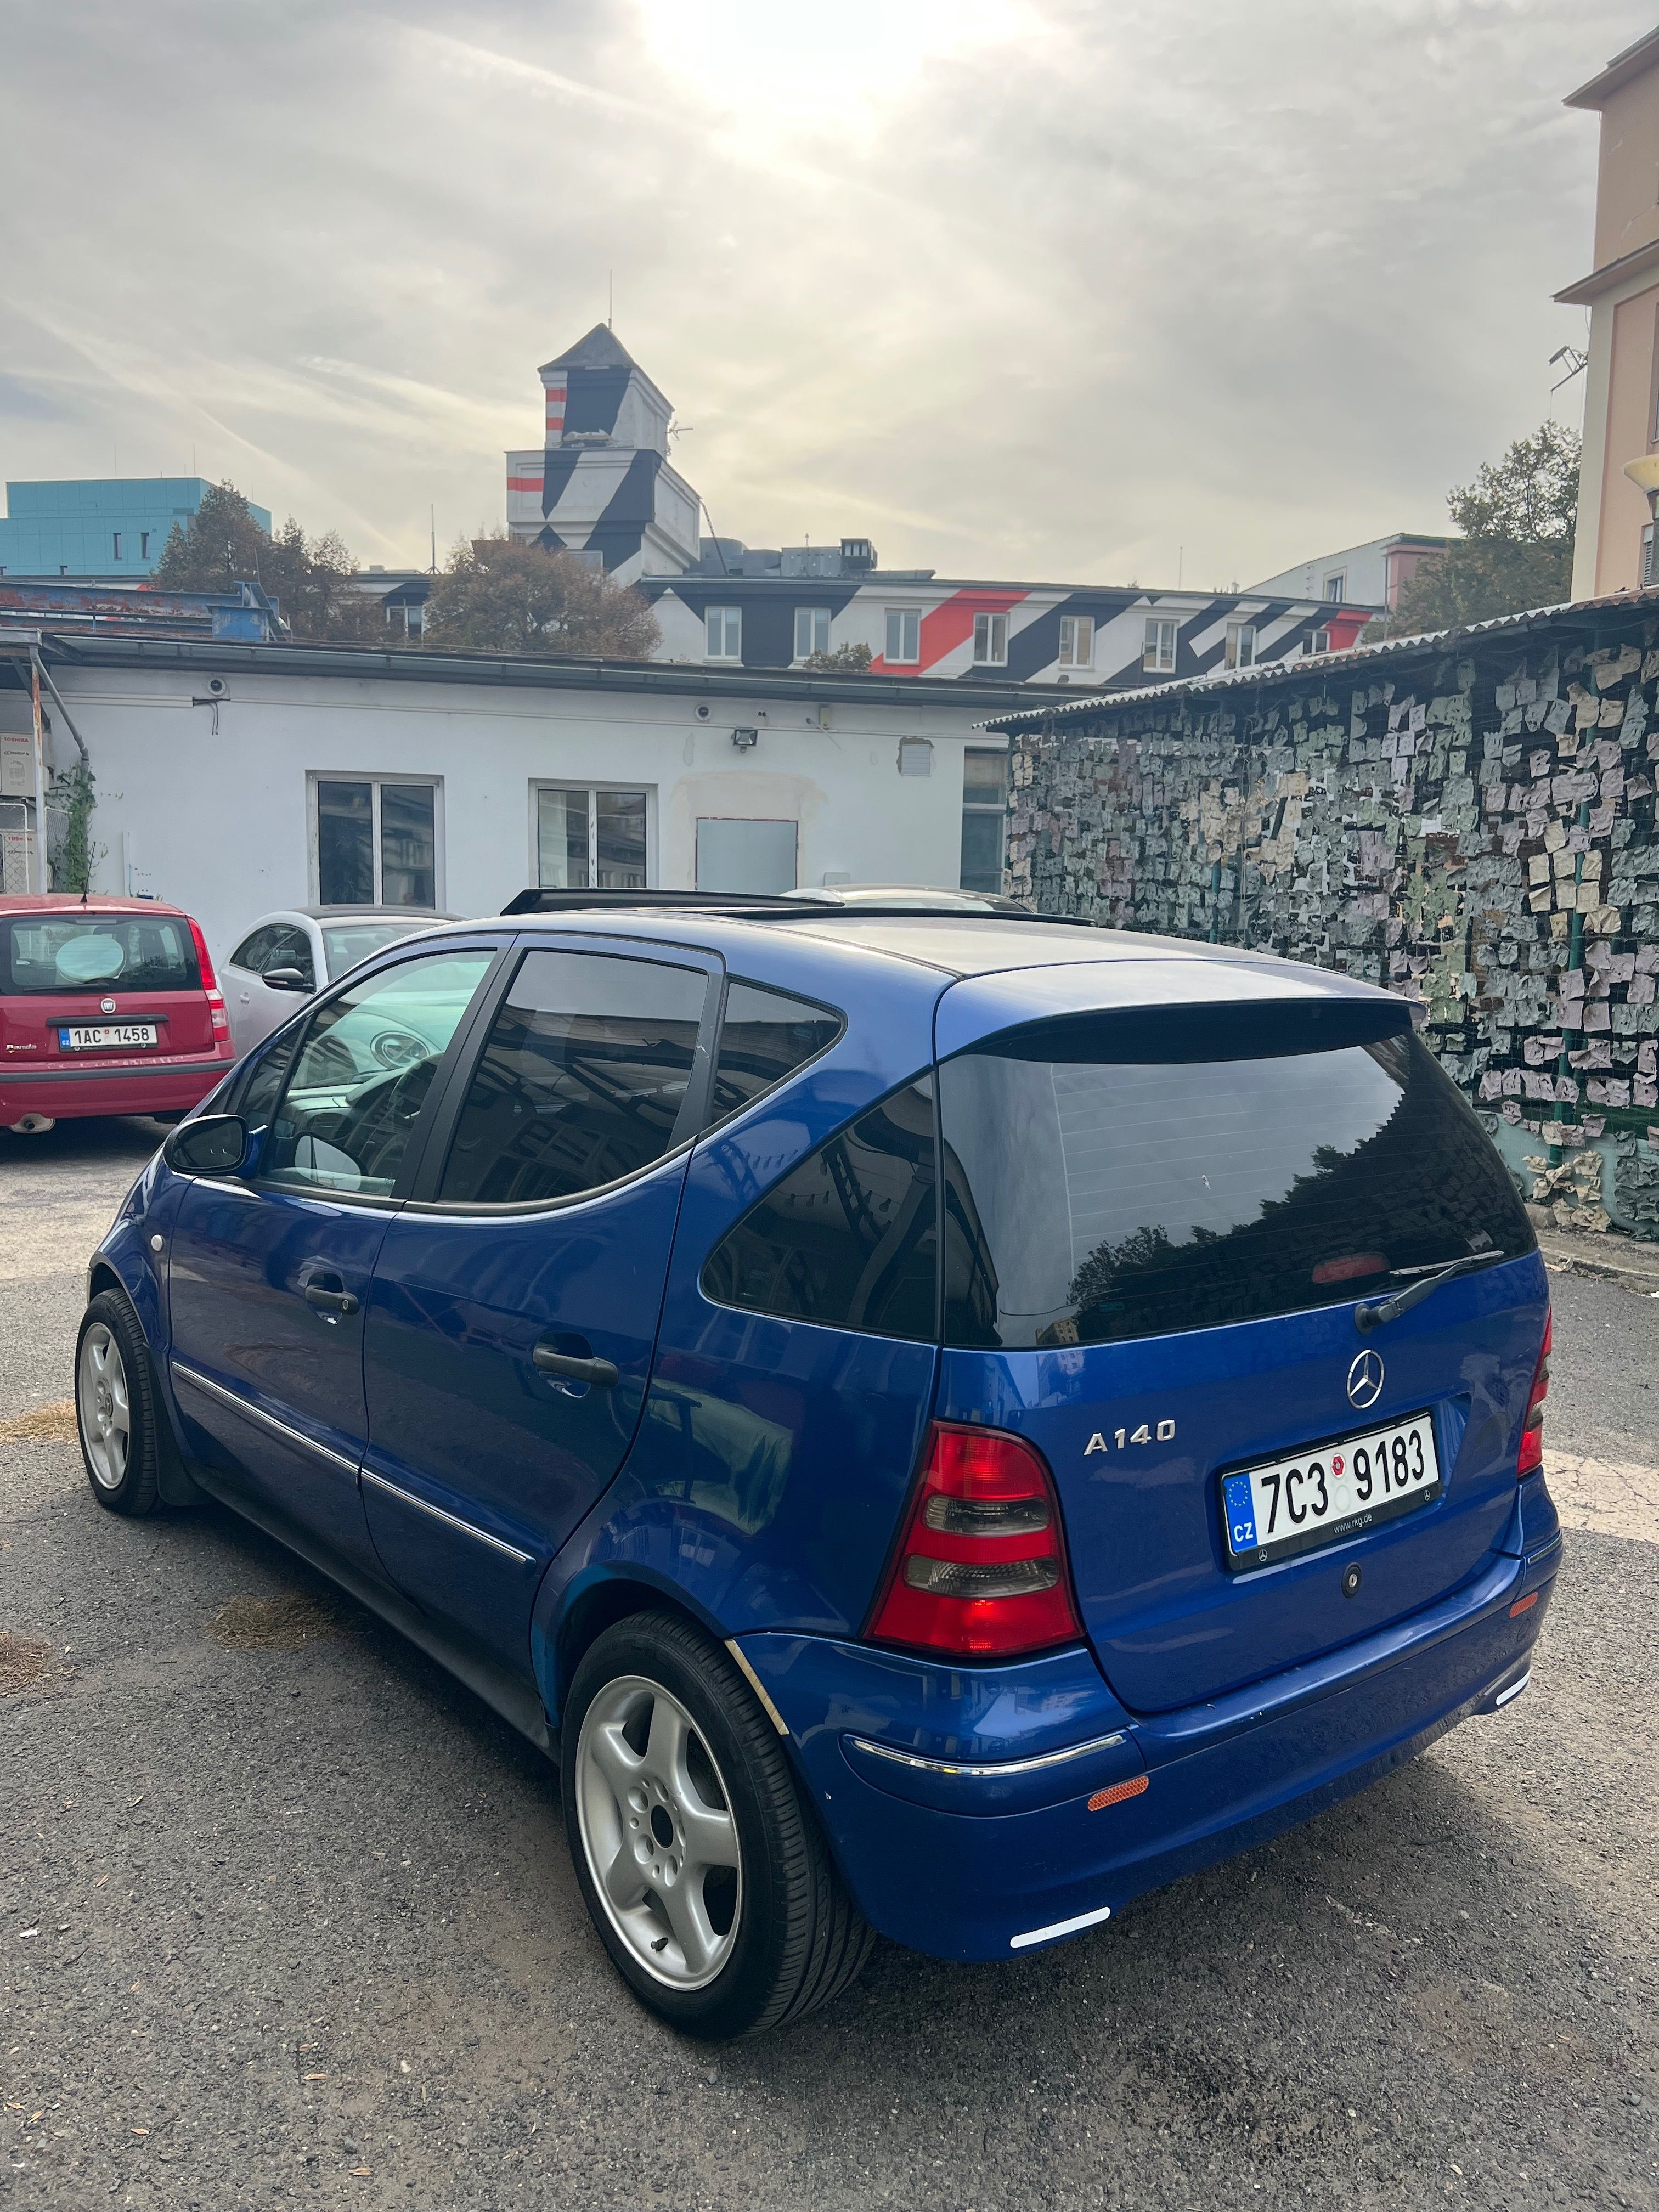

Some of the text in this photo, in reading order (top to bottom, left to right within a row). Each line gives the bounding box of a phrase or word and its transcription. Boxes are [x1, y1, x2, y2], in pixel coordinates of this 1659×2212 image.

[75, 1028, 150, 1044] 1AC 1458
[1084, 1419, 1176, 1455] A140
[1261, 1430, 1425, 1533] 7C3 9183
[1234, 1522, 1254, 1542] CZ
[1334, 1514, 1372, 1534] www.rkg.de
